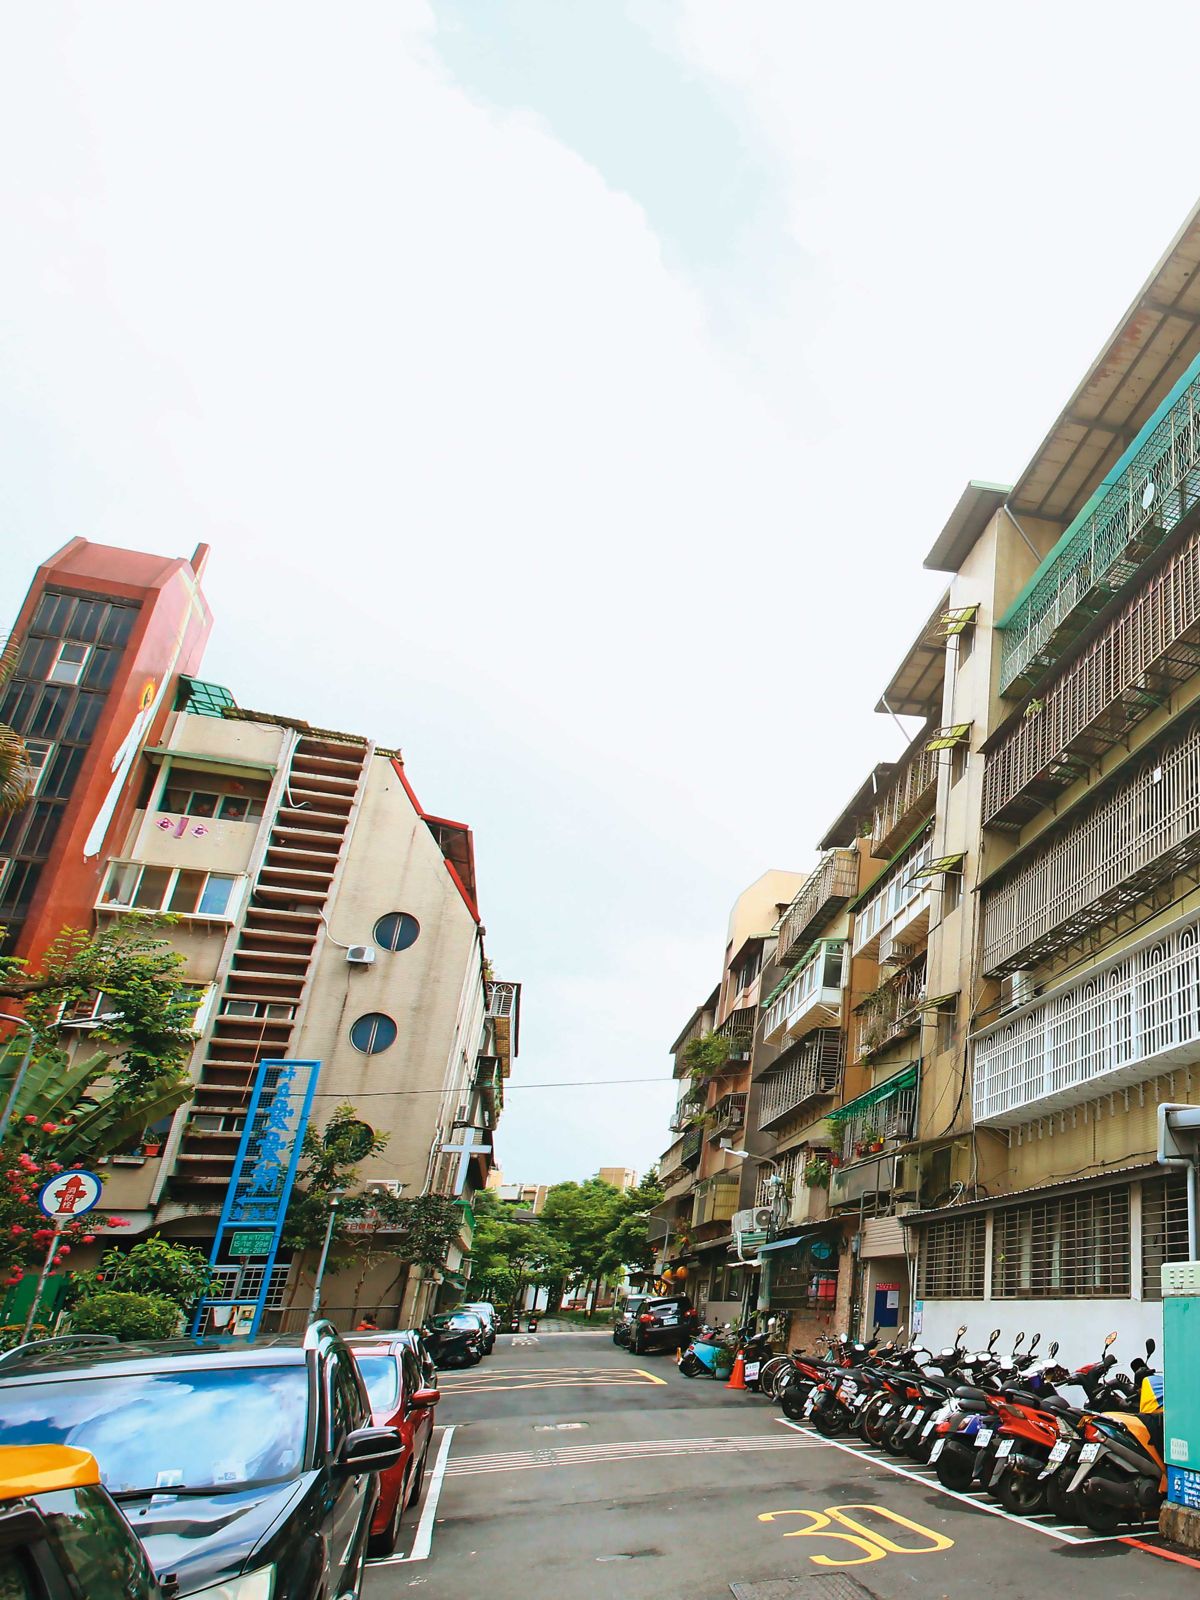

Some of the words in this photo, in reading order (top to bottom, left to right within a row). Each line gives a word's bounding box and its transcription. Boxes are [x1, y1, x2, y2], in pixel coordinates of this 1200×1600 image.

[62, 1186, 78, 1209] 消防栓
[757, 1504, 956, 1567] 30
